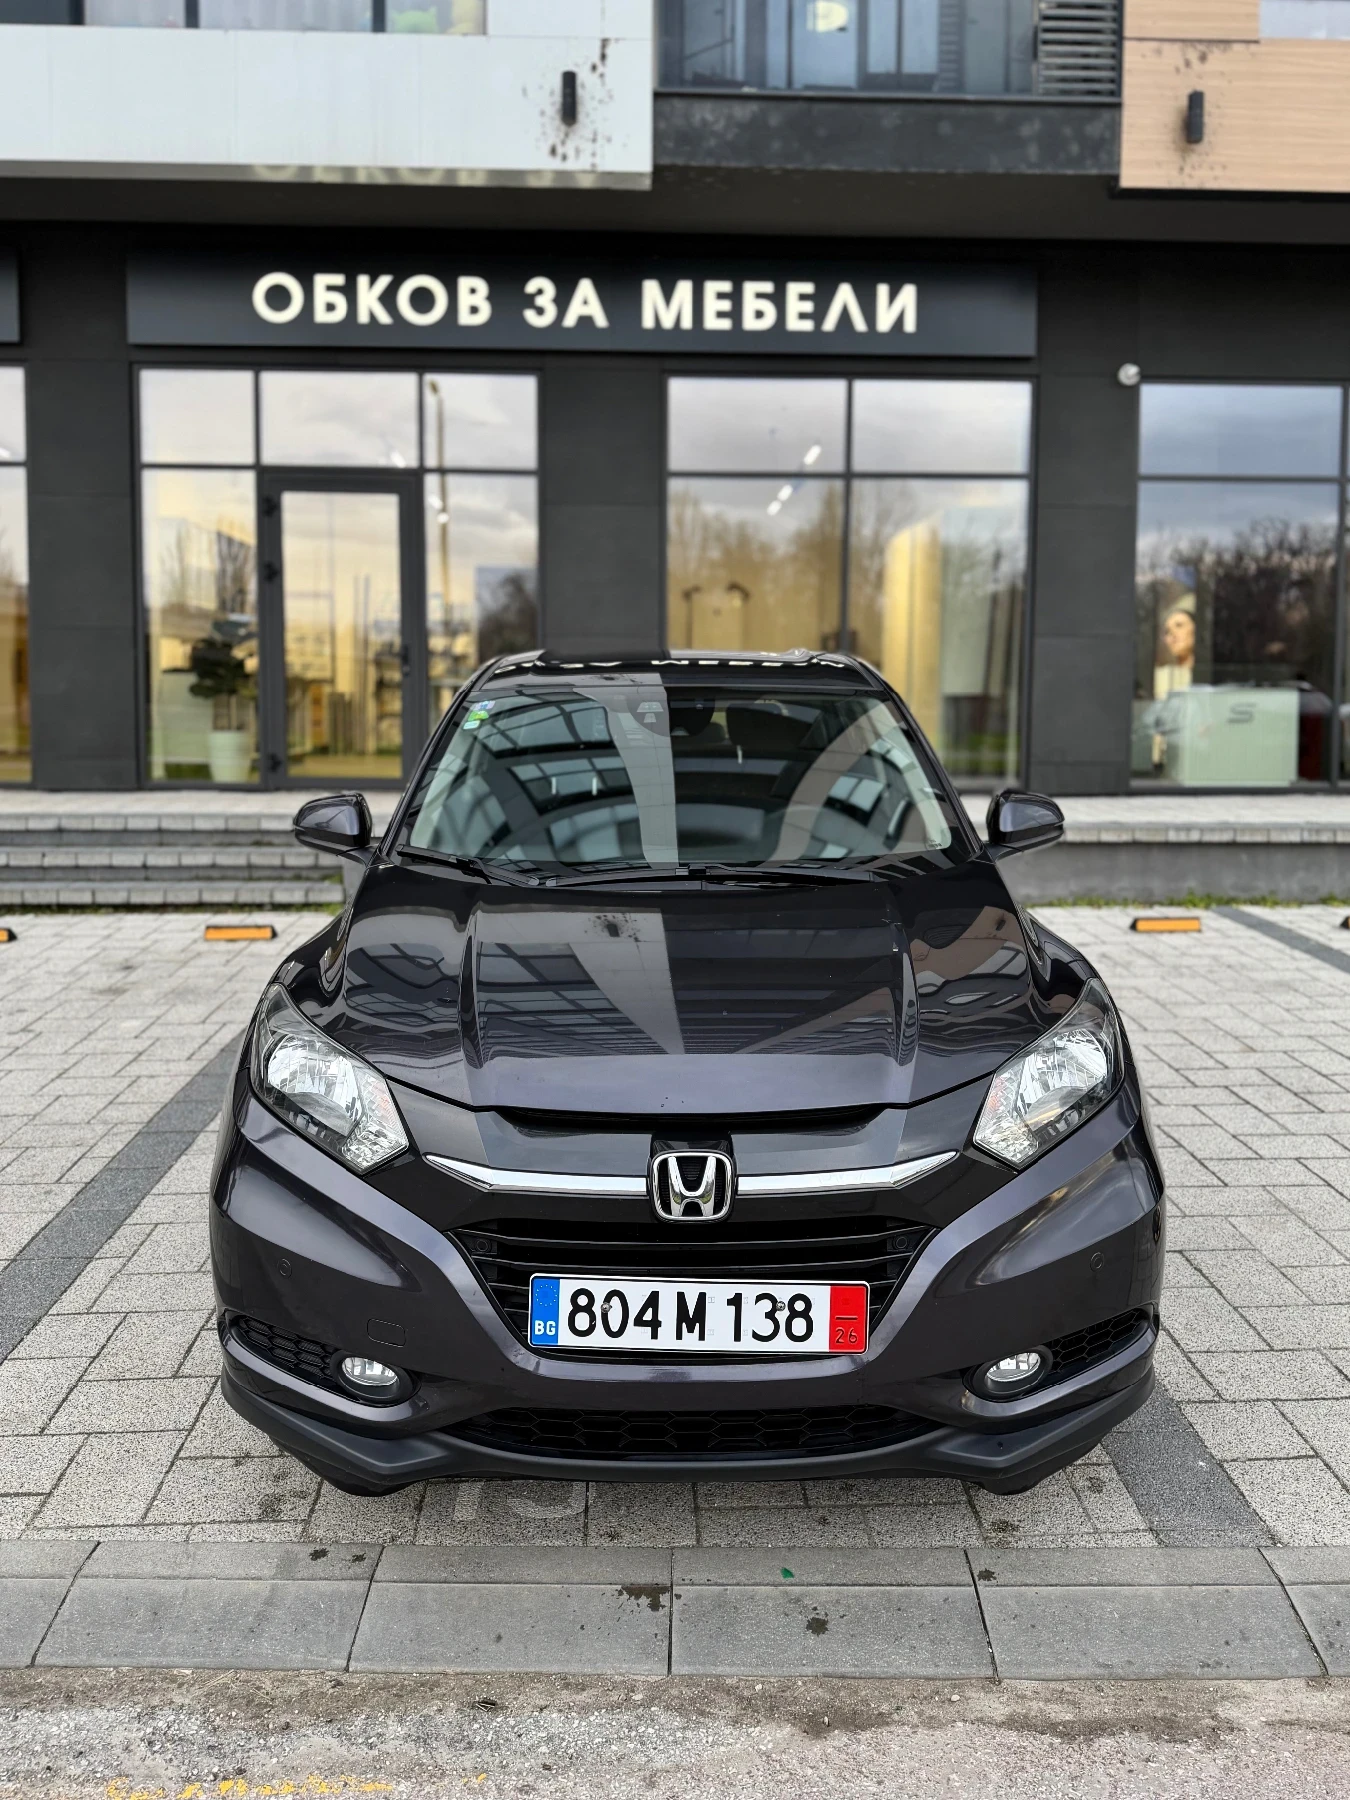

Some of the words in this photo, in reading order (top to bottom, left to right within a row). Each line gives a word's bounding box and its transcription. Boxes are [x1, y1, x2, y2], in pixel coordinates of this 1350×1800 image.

[252, 272, 492, 326] ОБКОВ
[523, 276, 609, 329] ЗА
[641, 279, 917, 334] МЕБЕЛИ
[534, 1320, 556, 1336] BG
[567, 1287, 662, 1340] 804
[675, 1291, 707, 1342] M
[726, 1292, 814, 1343] 138
[835, 1326, 858, 1344] 26
